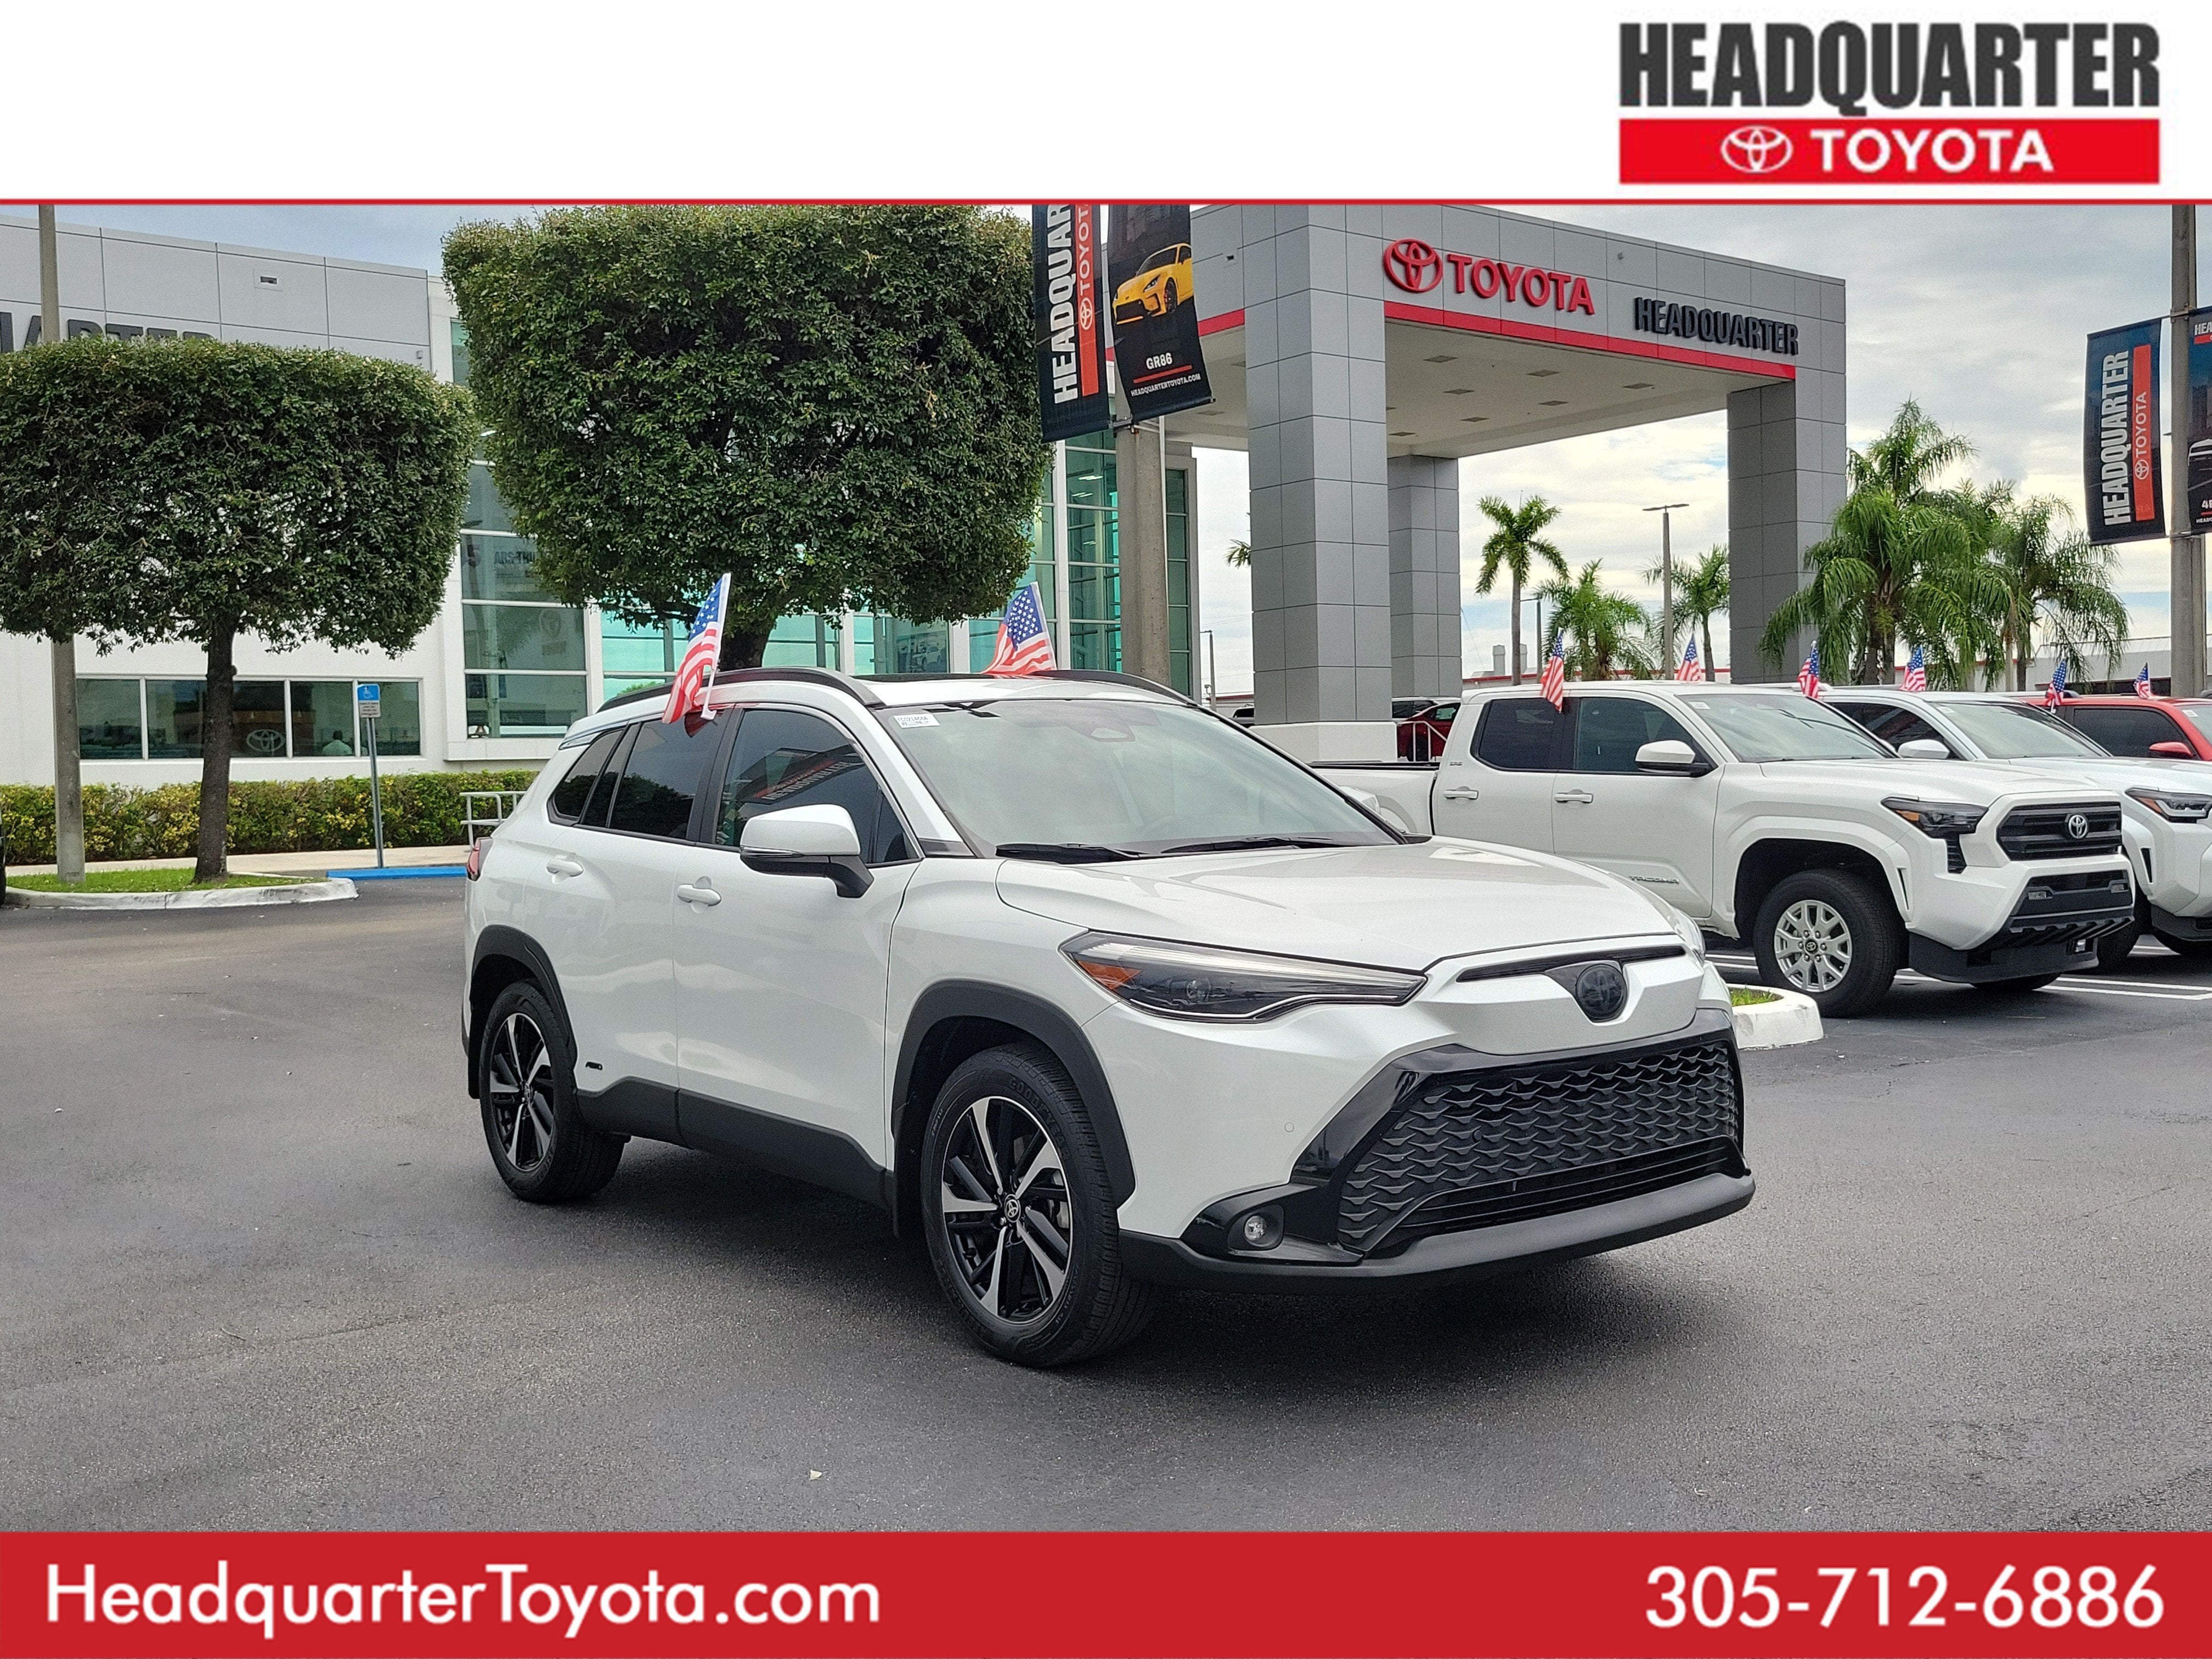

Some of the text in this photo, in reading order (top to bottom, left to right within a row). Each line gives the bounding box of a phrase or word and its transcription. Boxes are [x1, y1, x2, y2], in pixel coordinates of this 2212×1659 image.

[1078, 205, 1091, 296] TOYOT
[1447, 253, 1595, 315] TOYOTA
[1634, 296, 1799, 356] HEADQUARTER
[1130, 373, 1201, 397] HEADQUARTERTOYOTA.COM
[1146, 352, 1172, 370] GR86
[2101, 350, 2131, 526] HEADQUARTER
[2136, 391, 2147, 459] TOYOTA
